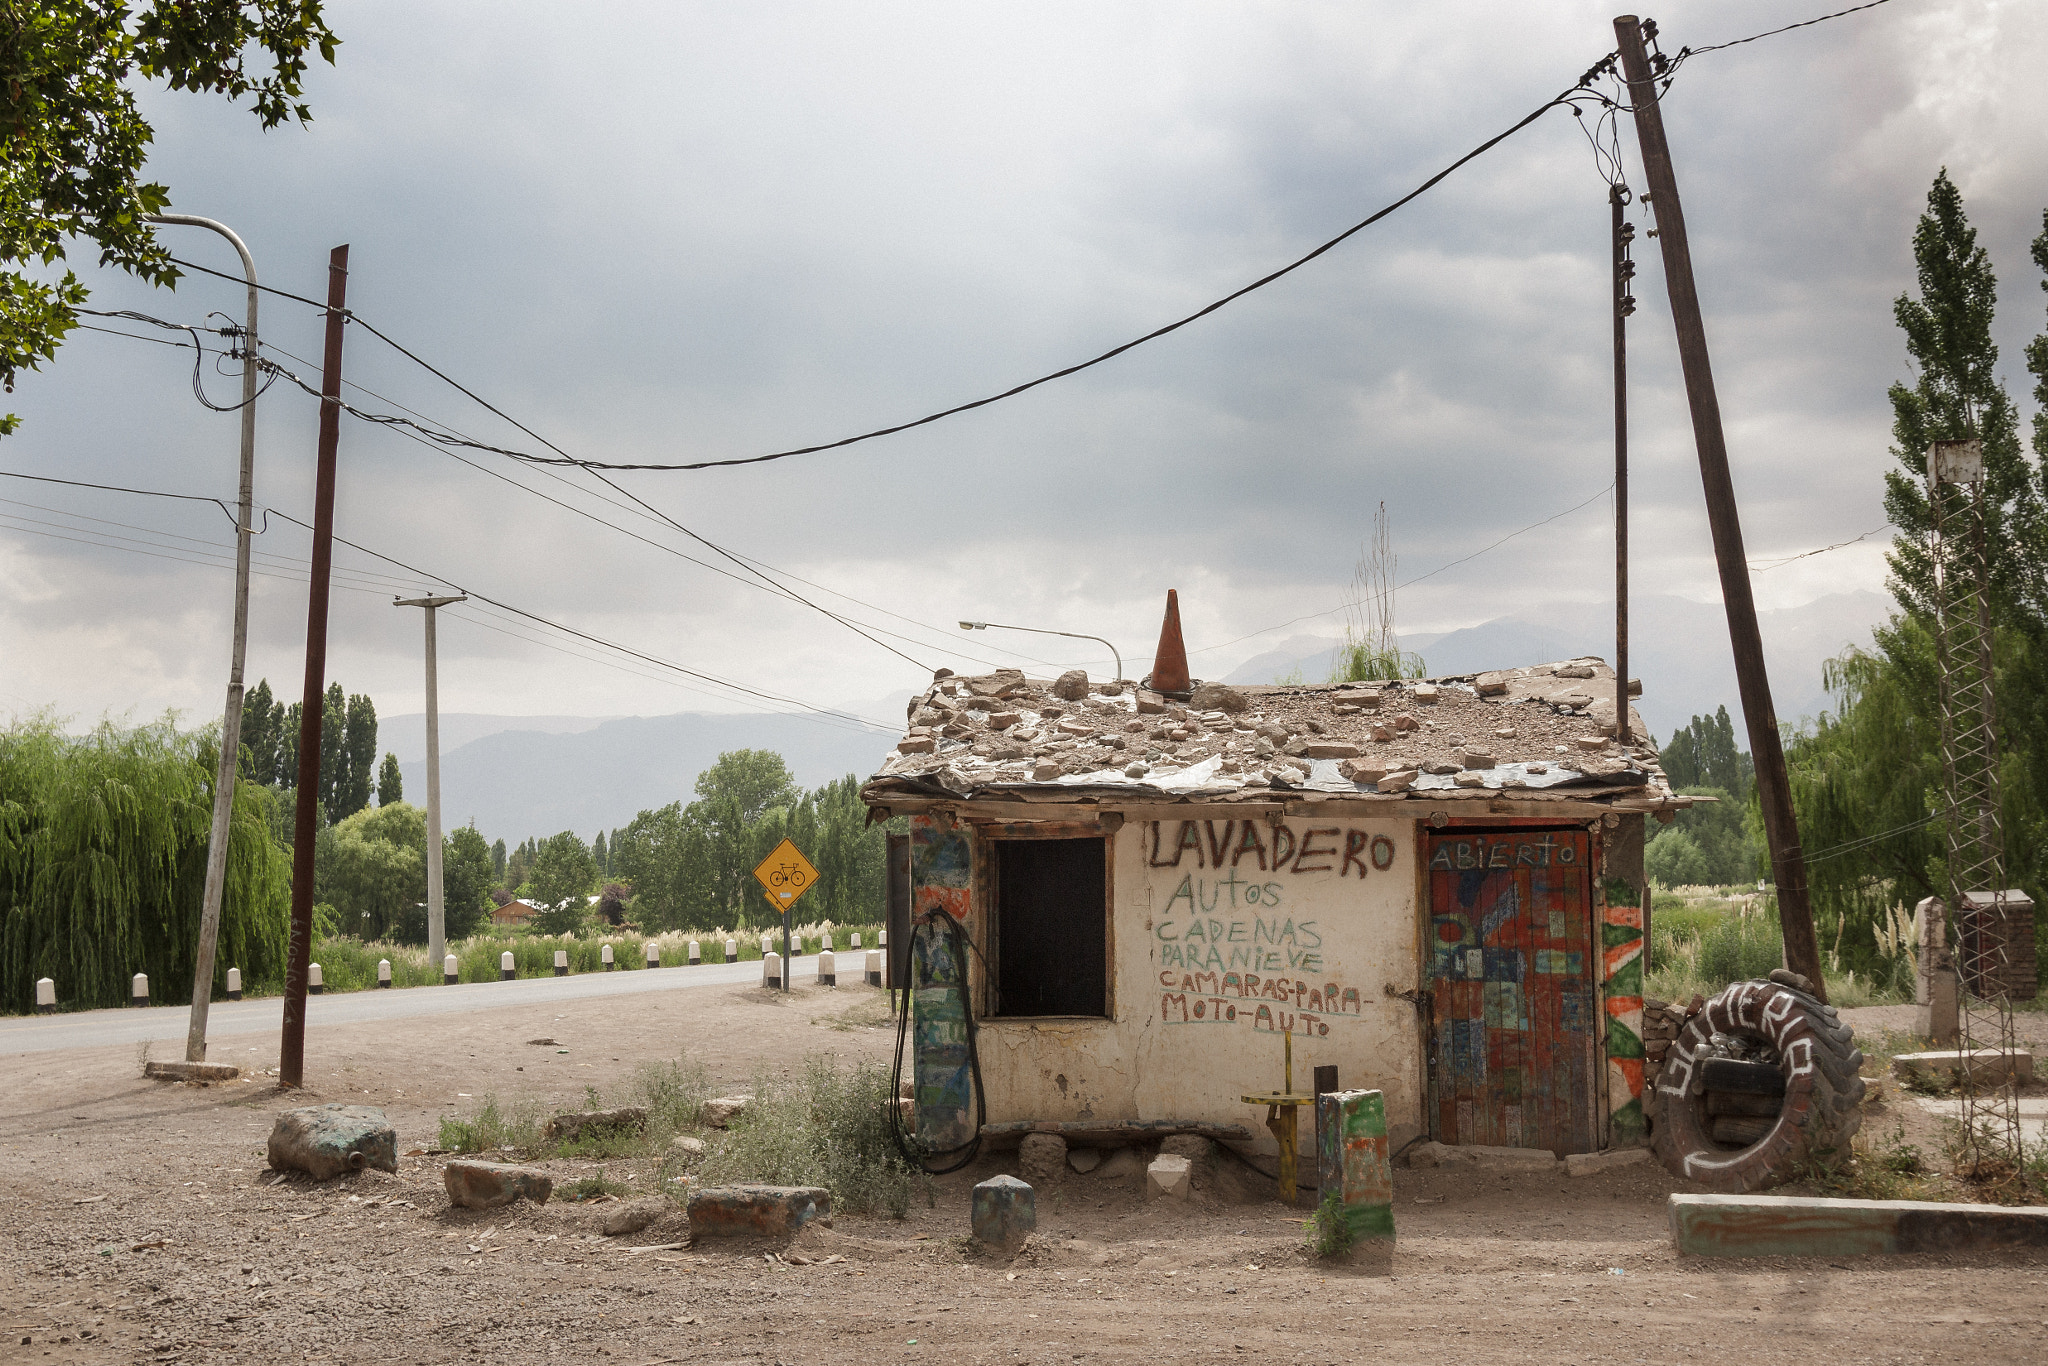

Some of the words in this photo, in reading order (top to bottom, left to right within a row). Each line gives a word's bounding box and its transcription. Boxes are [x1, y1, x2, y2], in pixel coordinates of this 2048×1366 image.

[1150, 820, 1395, 879] LAVADERO
[1430, 836, 1575, 869] ABIERTO
[1165, 868, 1283, 914] AUTOS
[1155, 918, 1322, 948] CADENAS
[1161, 943, 1226, 972] PARA
[1230, 942, 1324, 973] NIEVE
